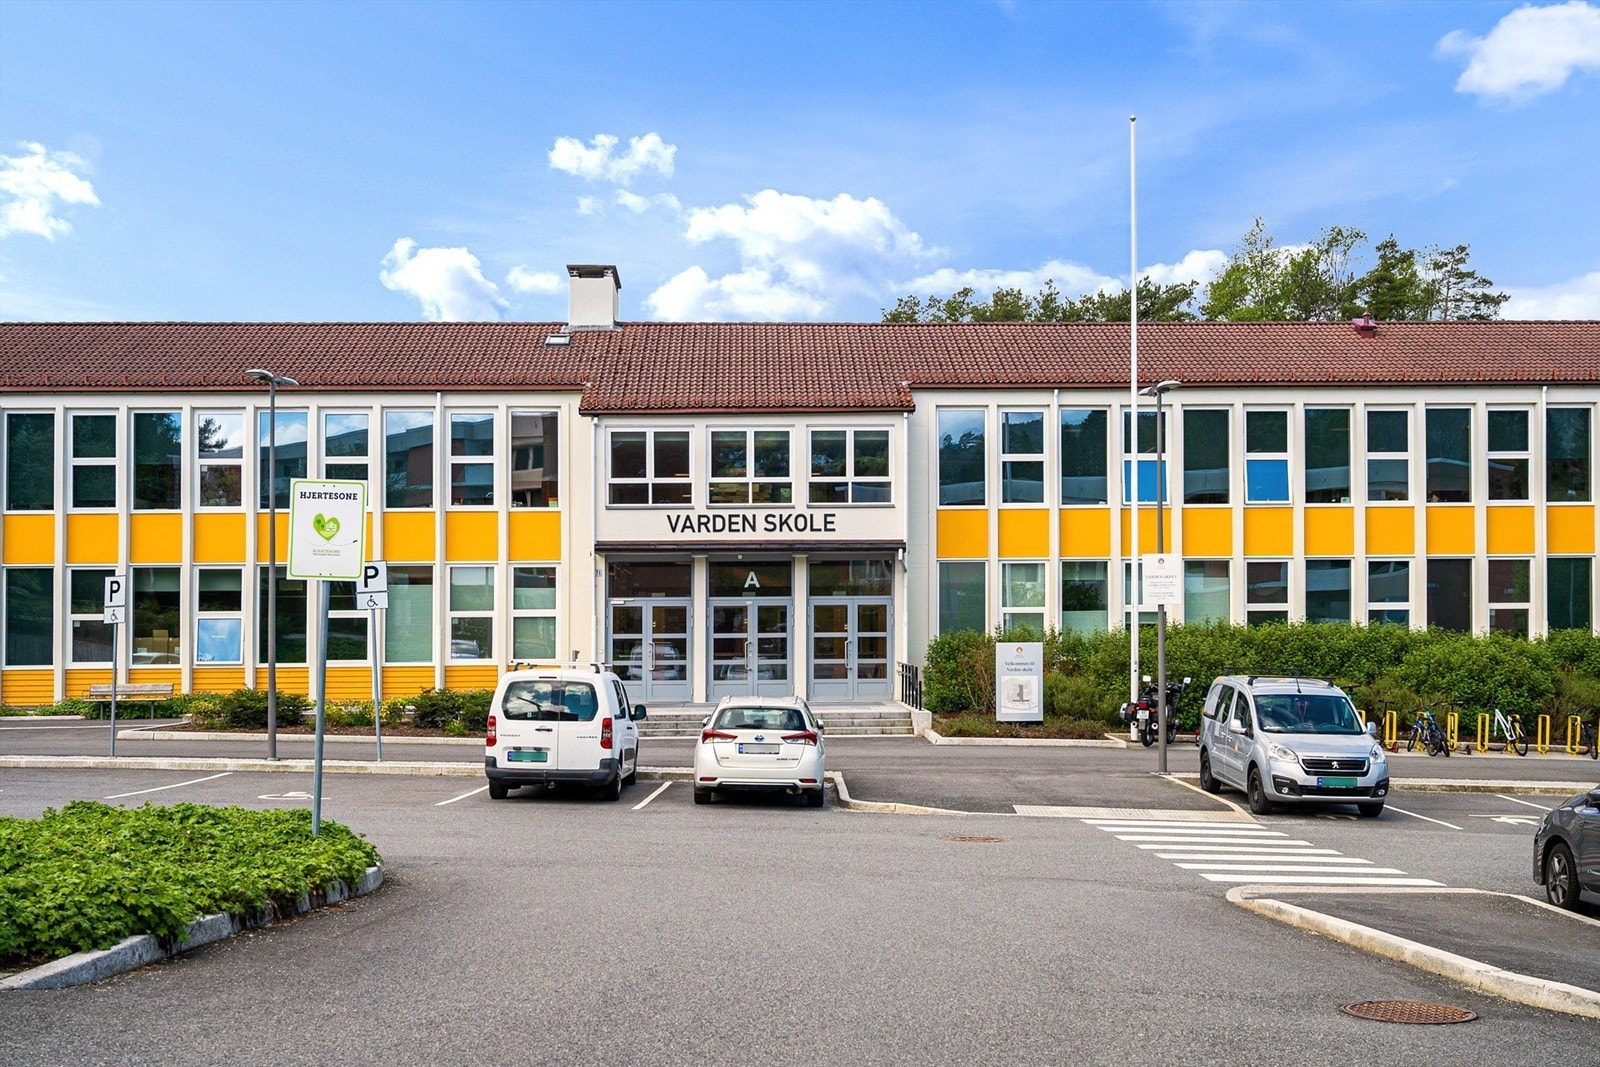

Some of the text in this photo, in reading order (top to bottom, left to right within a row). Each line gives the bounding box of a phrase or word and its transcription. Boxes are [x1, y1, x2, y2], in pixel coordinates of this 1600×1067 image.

[300, 491, 358, 501] HJERTESONE
[667, 513, 836, 533] VARDEN SKOLE
[364, 565, 380, 589] P
[744, 571, 760, 588] A
[109, 580, 121, 603] P
